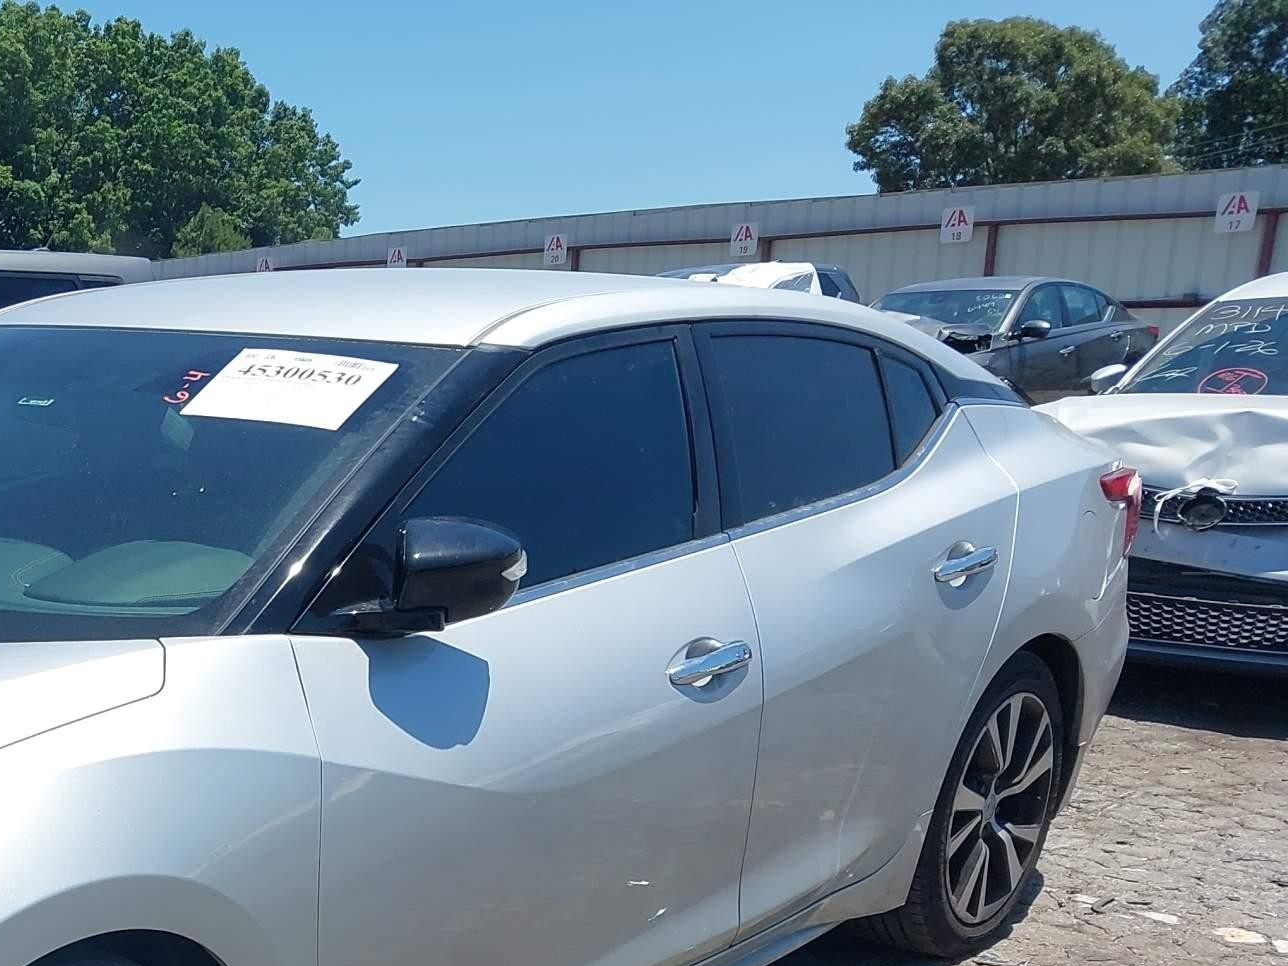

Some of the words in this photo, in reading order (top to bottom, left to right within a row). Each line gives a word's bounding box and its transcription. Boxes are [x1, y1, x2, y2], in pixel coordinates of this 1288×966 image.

[1228, 220, 1241, 230] 17
[951, 231, 962, 241] 18
[739, 246, 748, 254] 19
[550, 255, 560, 263] 20
[238, 363, 362, 386] 45300530
